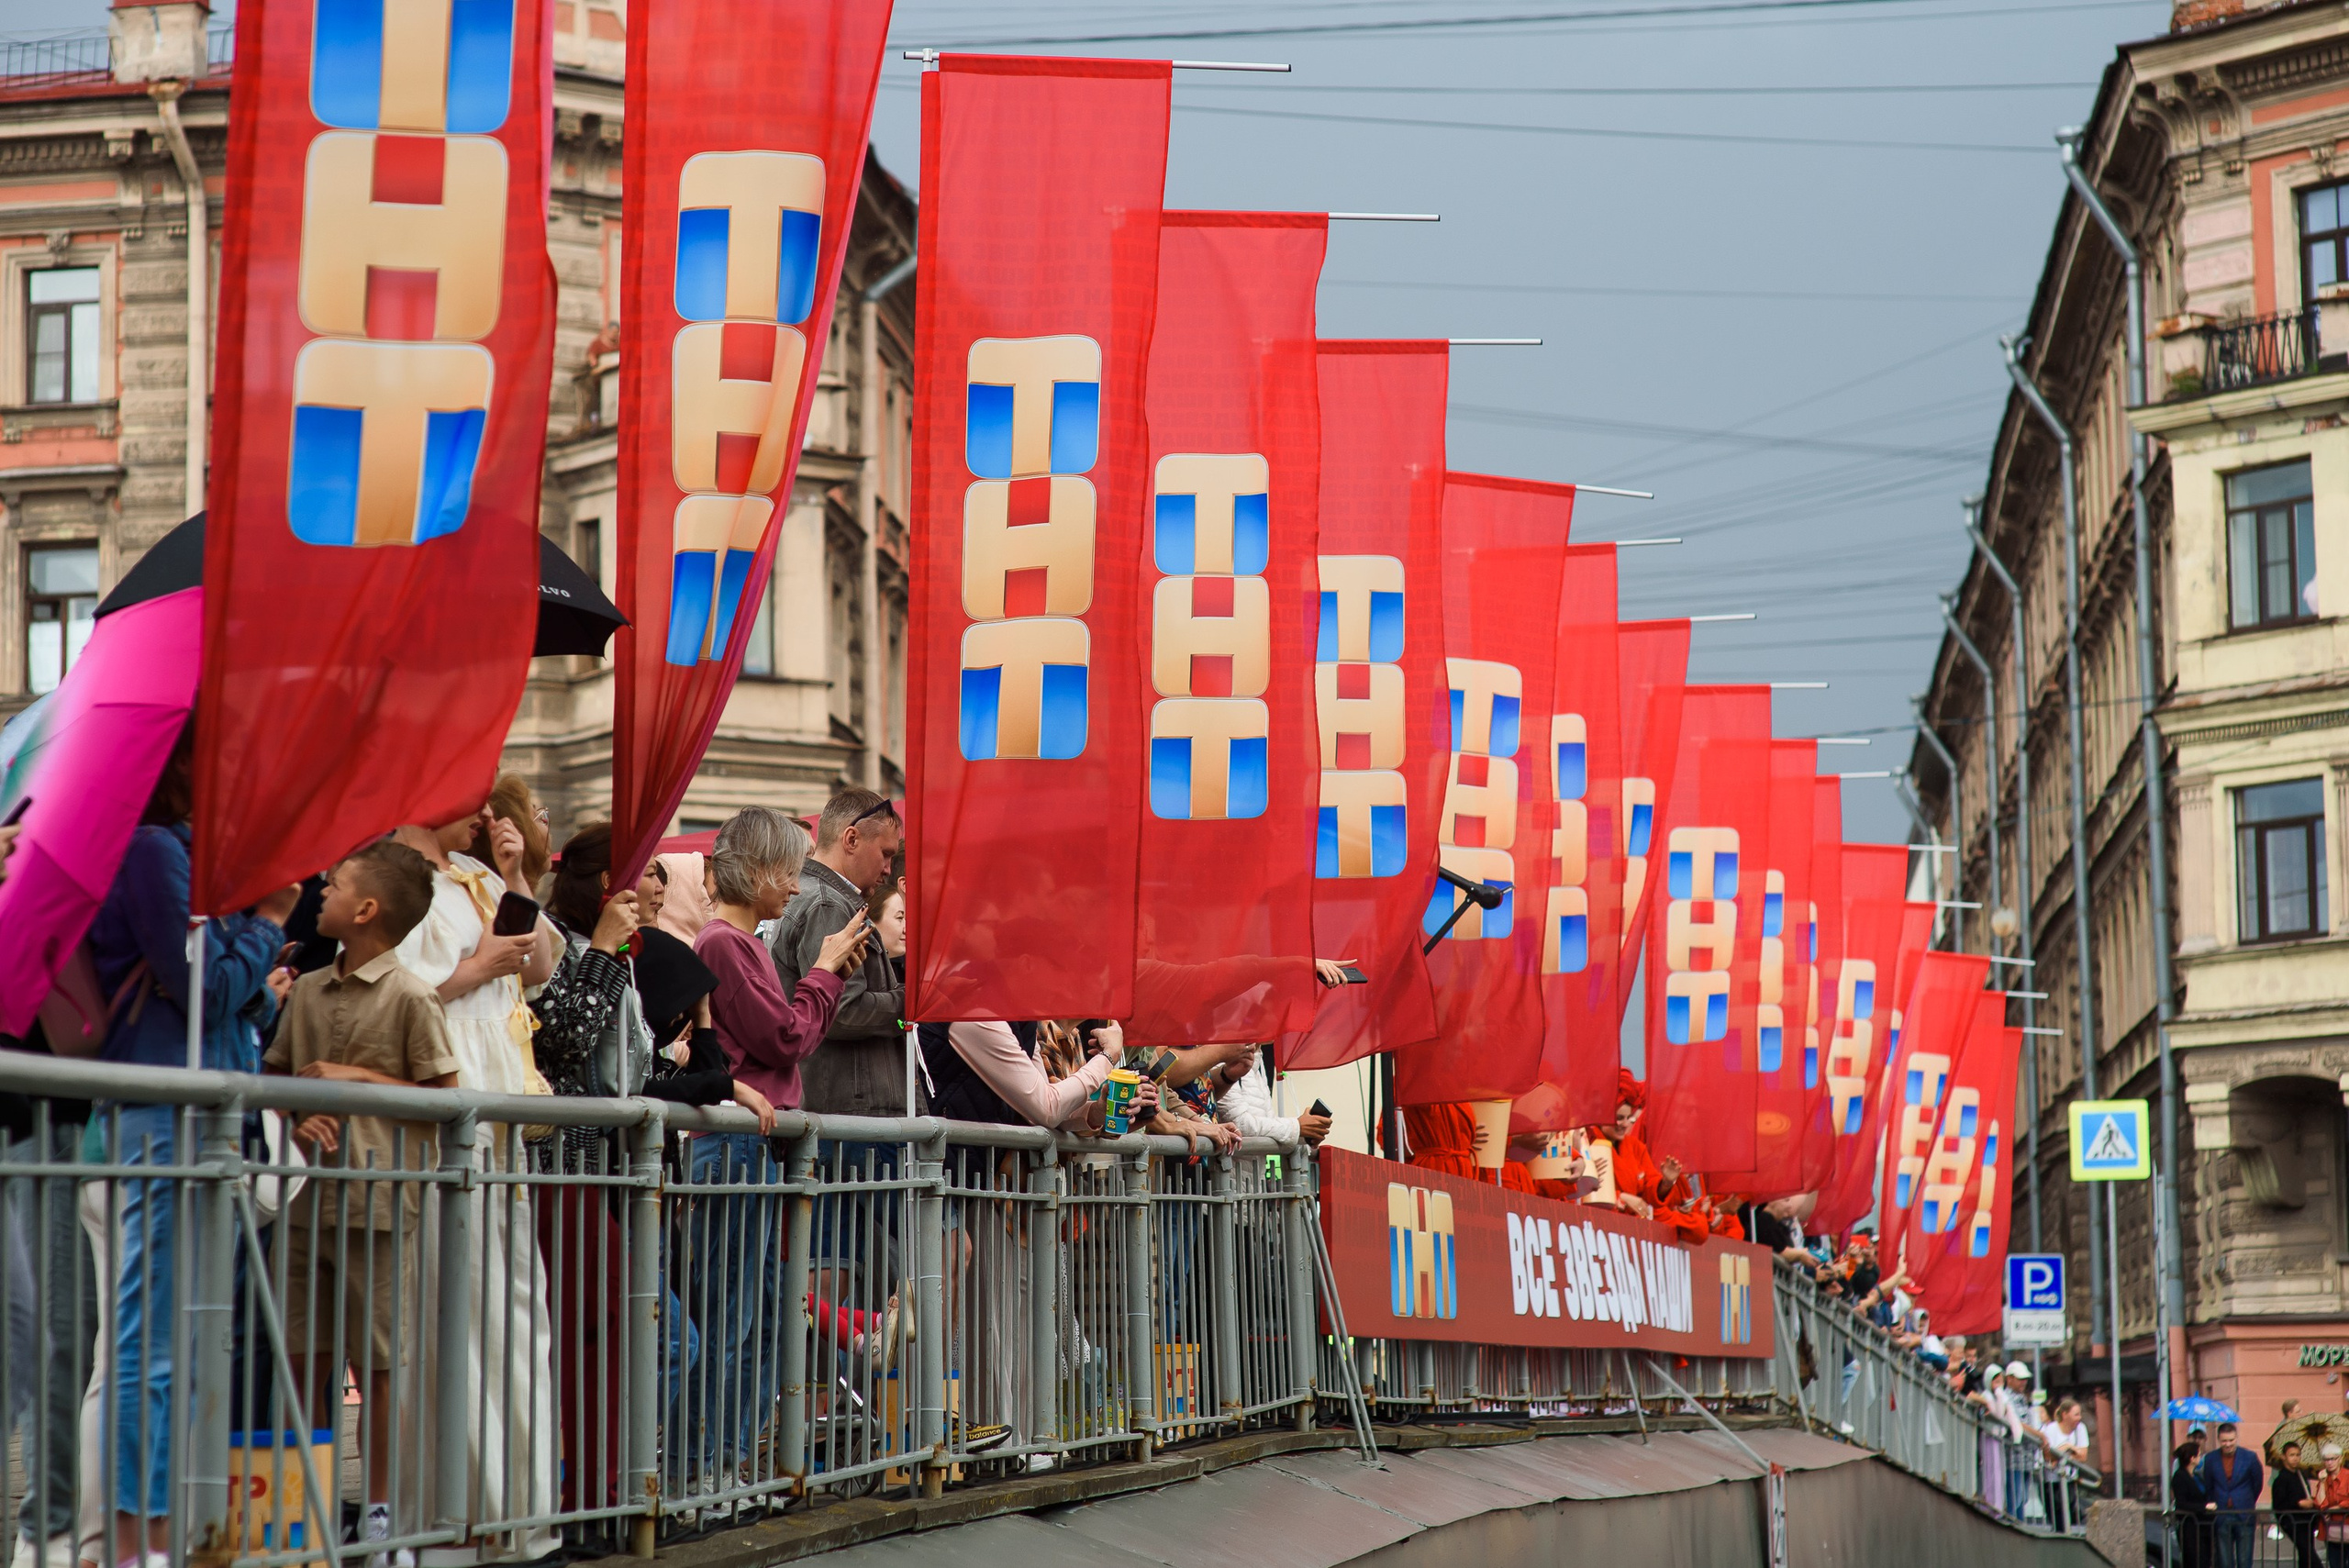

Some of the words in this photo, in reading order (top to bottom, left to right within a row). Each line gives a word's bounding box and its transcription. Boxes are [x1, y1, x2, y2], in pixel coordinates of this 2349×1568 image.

[538, 584, 571, 598] LVO
[959, 335, 1101, 761] ТНТ
[1149, 452, 1270, 819] ТНТ
[1315, 555, 1408, 878] ТНТ
[1422, 657, 1523, 940] ТНТ
[1666, 827, 1740, 1045] ТНТ
[1387, 1182, 1457, 1319] ТНТ
[1507, 1211, 1561, 1318] ВСЕ
[1558, 1220, 1649, 1333] ЗВЁЗДЫ
[1640, 1240, 1694, 1333] НАШИ
[1720, 1252, 1751, 1345] ТНТ
[2023, 1262, 2054, 1306] P
[969, 1429, 1001, 1440] balance
